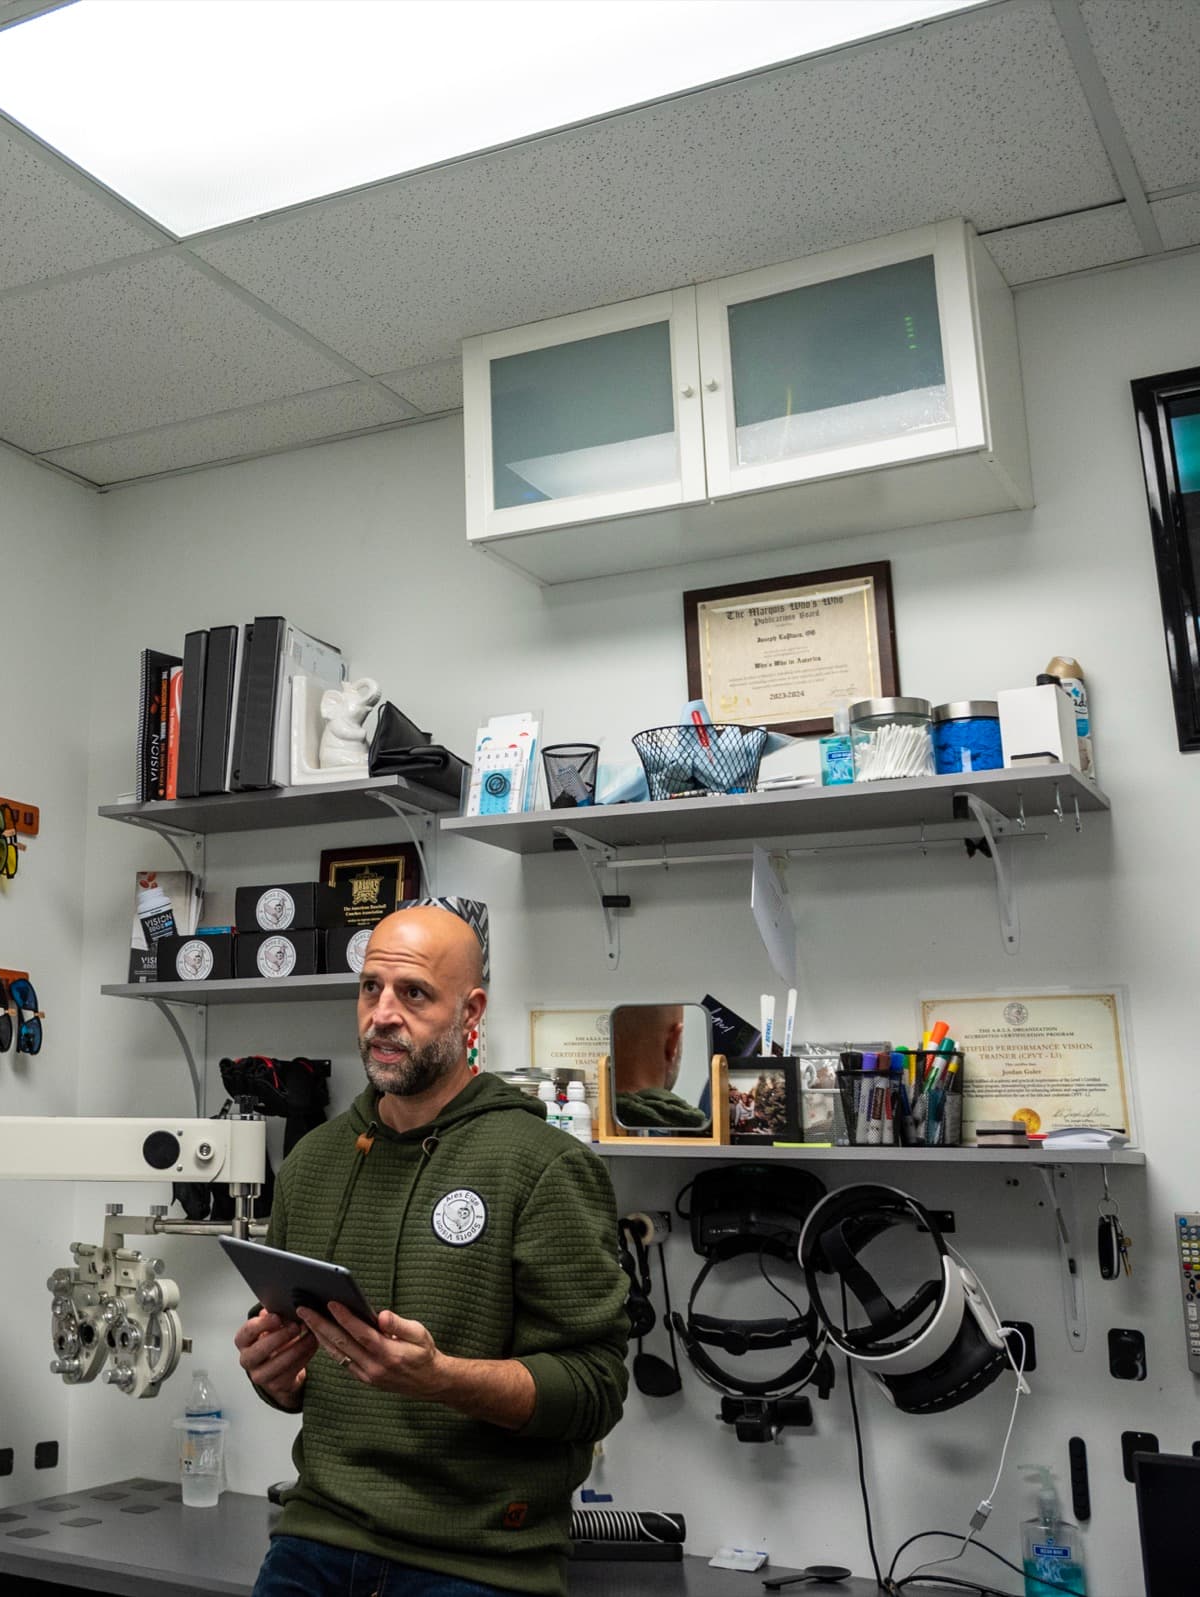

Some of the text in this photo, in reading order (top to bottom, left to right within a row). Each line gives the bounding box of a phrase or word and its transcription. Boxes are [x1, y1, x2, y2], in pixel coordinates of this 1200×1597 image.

[726, 596, 843, 621] The Marquis Who's Who
[150, 733, 160, 783] VISION
[144, 912, 173, 929] VISION
[140, 956, 158, 964] VISI
[1062, 1042, 1094, 1050] VISION
[446, 1191, 463, 1202] Ares
[435, 1219, 482, 1241] Vision Sports
